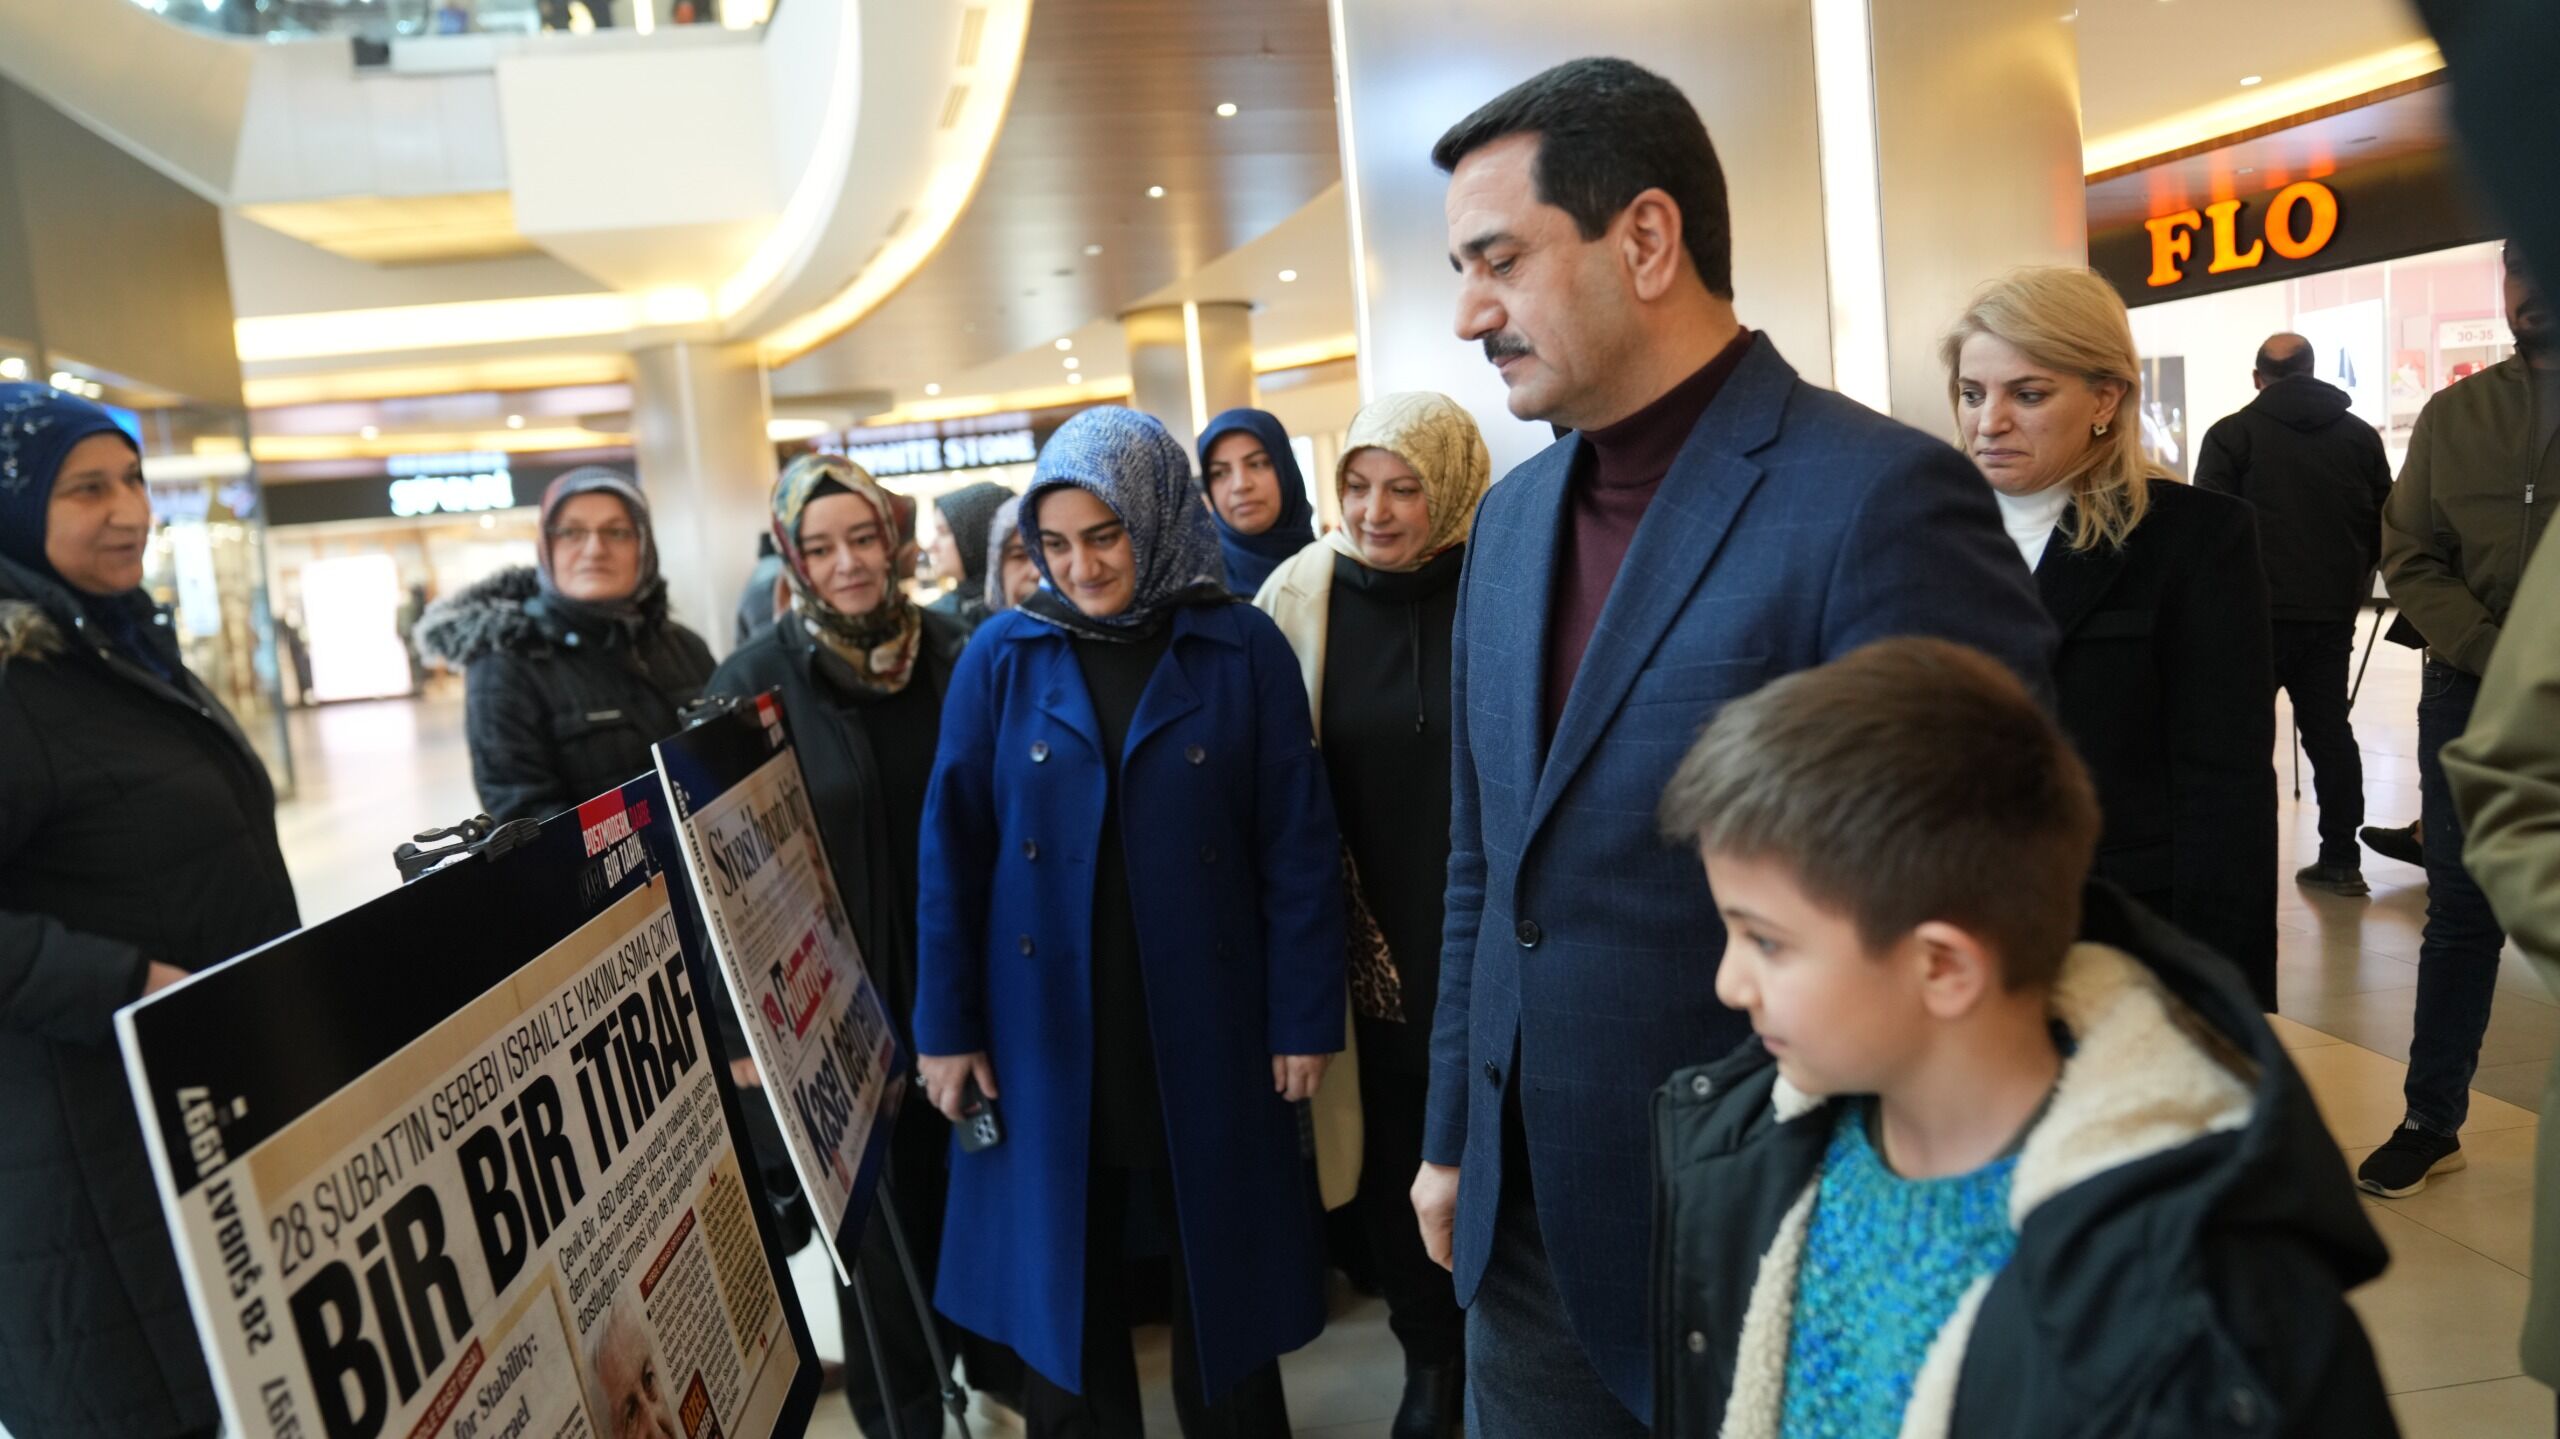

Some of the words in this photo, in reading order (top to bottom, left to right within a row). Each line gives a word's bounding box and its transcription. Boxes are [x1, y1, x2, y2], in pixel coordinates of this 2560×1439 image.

[2144, 181, 2338, 287] FLO
[177, 1086, 228, 1180] 1997
[269, 1202, 314, 1278] 28
[314, 1106, 434, 1250] ŞUBAT'IN
[573, 931, 654, 1021] YAKINLAŞMA
[649, 911, 677, 965] ÇIKTI
[205, 1178, 264, 1301] ŞUBAT
[597, 1190, 616, 1228] ABD
[622, 1190, 649, 1233] sadece
[658, 1195, 670, 1222] de
[240, 1295, 273, 1356] 28
[477, 1333, 538, 1420] Stability:
